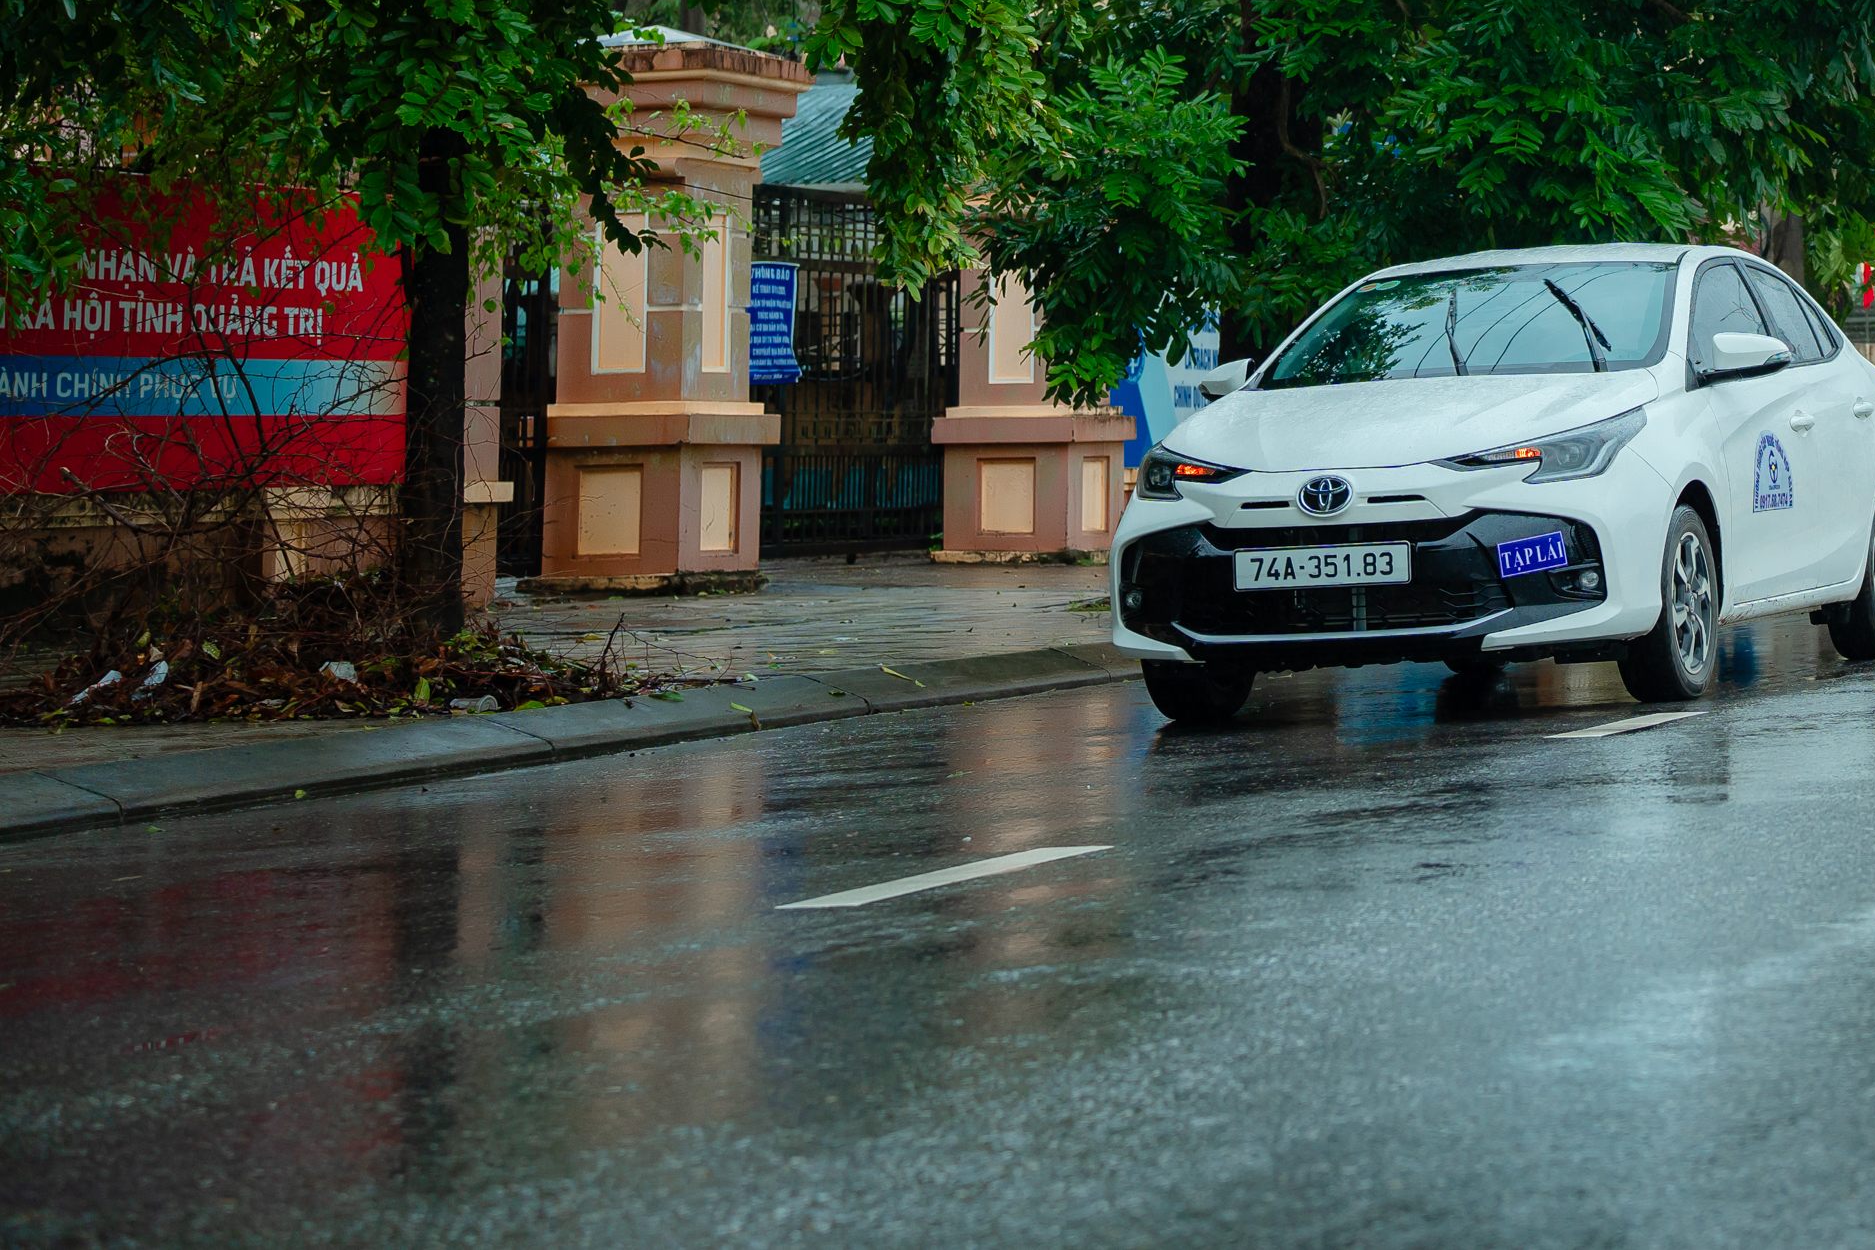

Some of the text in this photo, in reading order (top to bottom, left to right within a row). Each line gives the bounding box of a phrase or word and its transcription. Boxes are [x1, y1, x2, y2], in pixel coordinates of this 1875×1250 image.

[77, 246, 157, 289] NHẬN
[263, 245, 310, 289] KẾT
[314, 252, 364, 297] QUẢ
[63, 291, 112, 340] HỘI
[118, 290, 184, 334] TỈNH
[191, 293, 278, 336] QUẢNG
[283, 306, 324, 345] TRỊ
[56, 367, 131, 399] CHÍNH
[1250, 551, 1394, 582] 74A-351.83
[1501, 538, 1566, 574] TẬP LÁI
